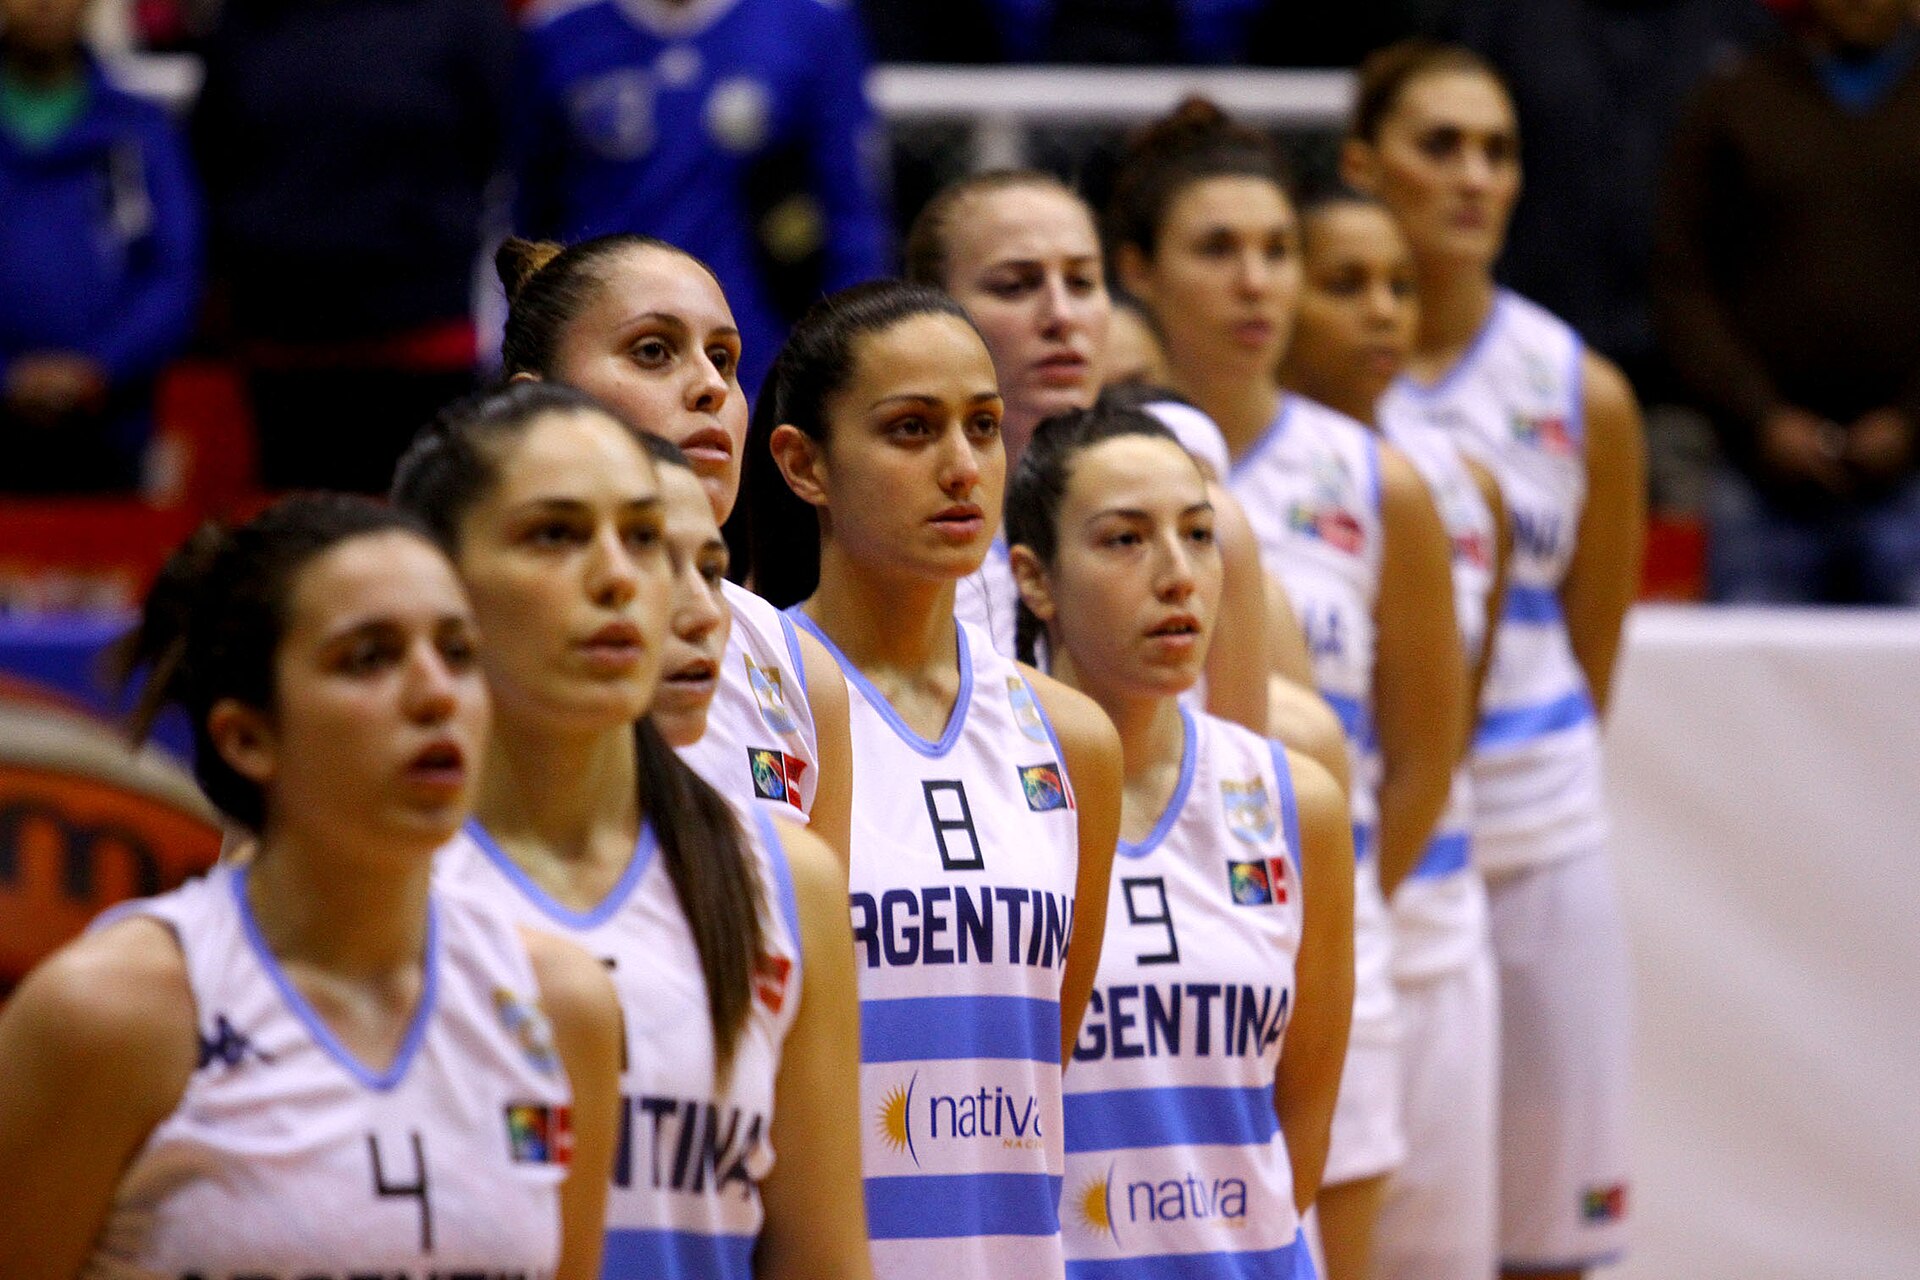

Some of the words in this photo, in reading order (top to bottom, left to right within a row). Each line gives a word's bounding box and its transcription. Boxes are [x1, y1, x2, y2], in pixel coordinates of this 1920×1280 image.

[922, 779, 985, 871] 8
[849, 885, 1074, 969] RGENTIN
[1121, 876, 1180, 965] 9
[1002, 1139, 1044, 1150] NAC
[367, 1131, 434, 1254] 4
